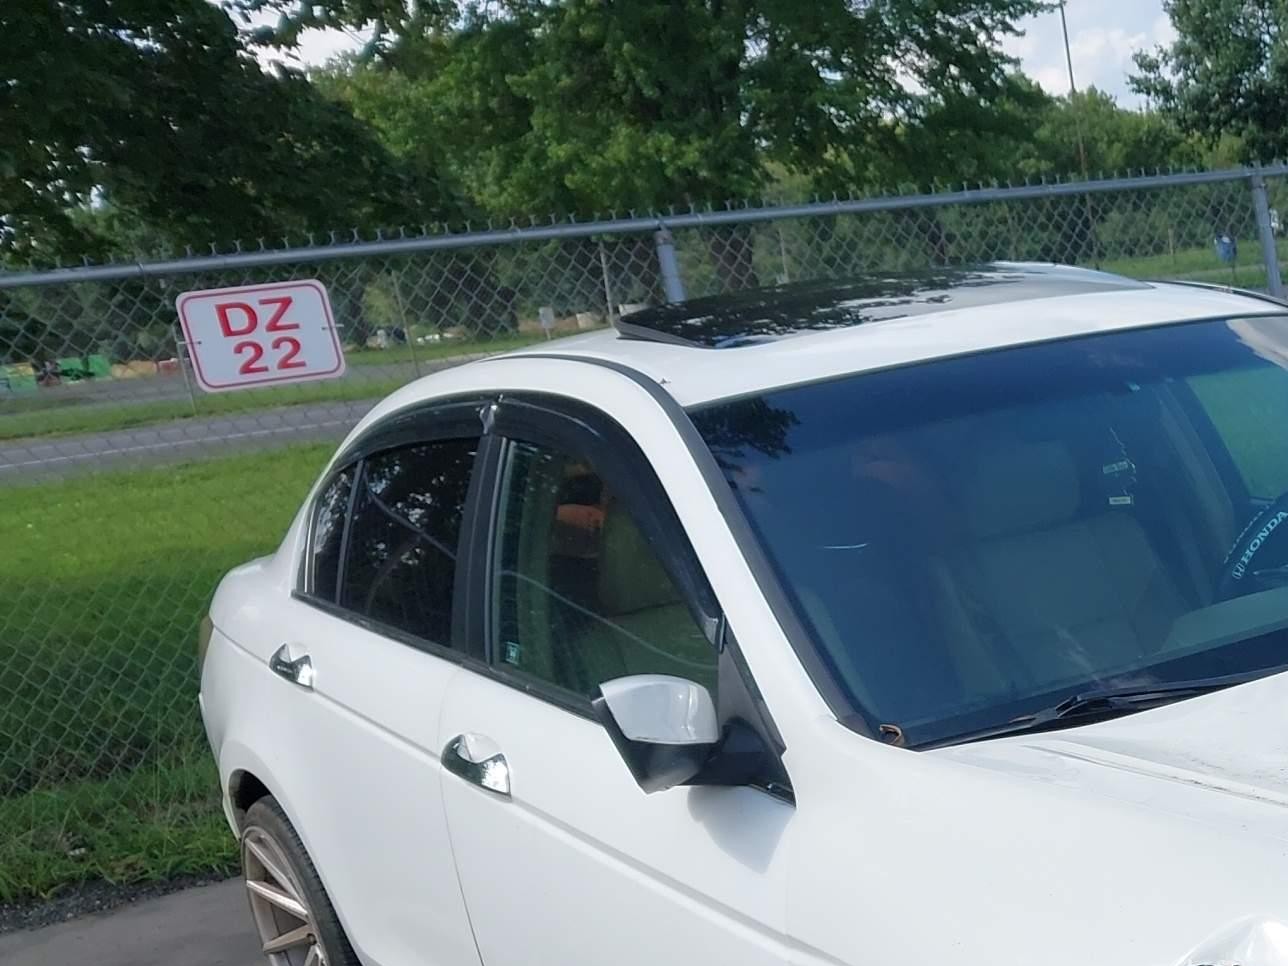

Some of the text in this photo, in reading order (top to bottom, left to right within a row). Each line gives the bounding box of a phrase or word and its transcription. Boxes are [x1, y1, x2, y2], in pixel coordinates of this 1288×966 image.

[215, 296, 299, 338] DZ
[233, 336, 307, 375] 22
[1241, 511, 1288, 564] HONDA
